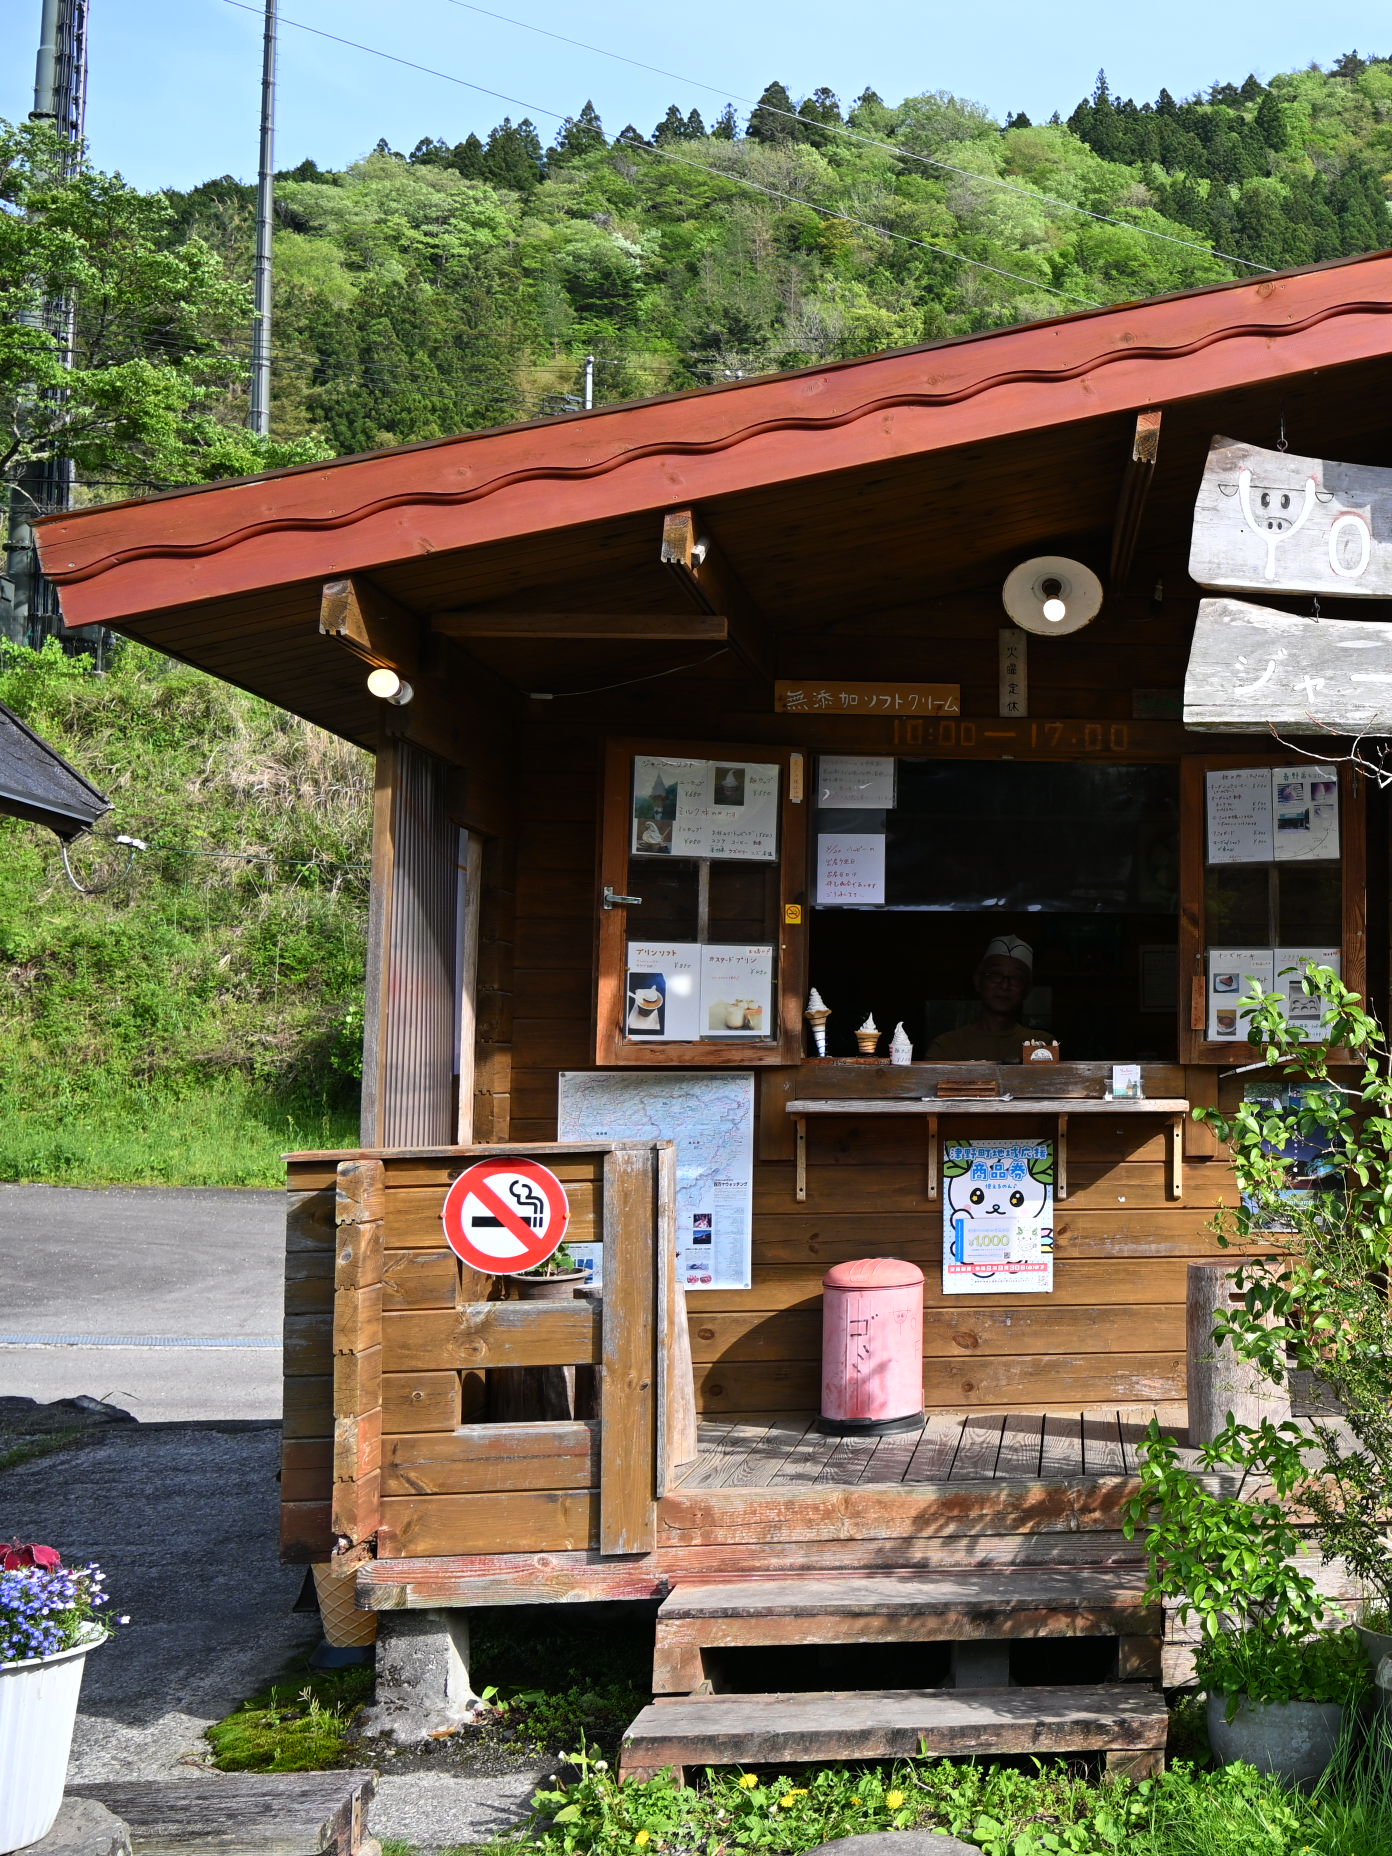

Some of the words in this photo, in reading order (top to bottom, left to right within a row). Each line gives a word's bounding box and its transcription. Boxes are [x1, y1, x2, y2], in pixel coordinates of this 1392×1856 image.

[1006, 646, 1019, 713] 火曜定休
[785, 690, 959, 712] 無添加ソフトクリーム
[894, 719, 976, 746] 10:00
[635, 949, 677, 957] プリンソフト
[949, 1145, 1047, 1160] 津野町地域応援
[971, 1160, 1027, 1181] 商品券
